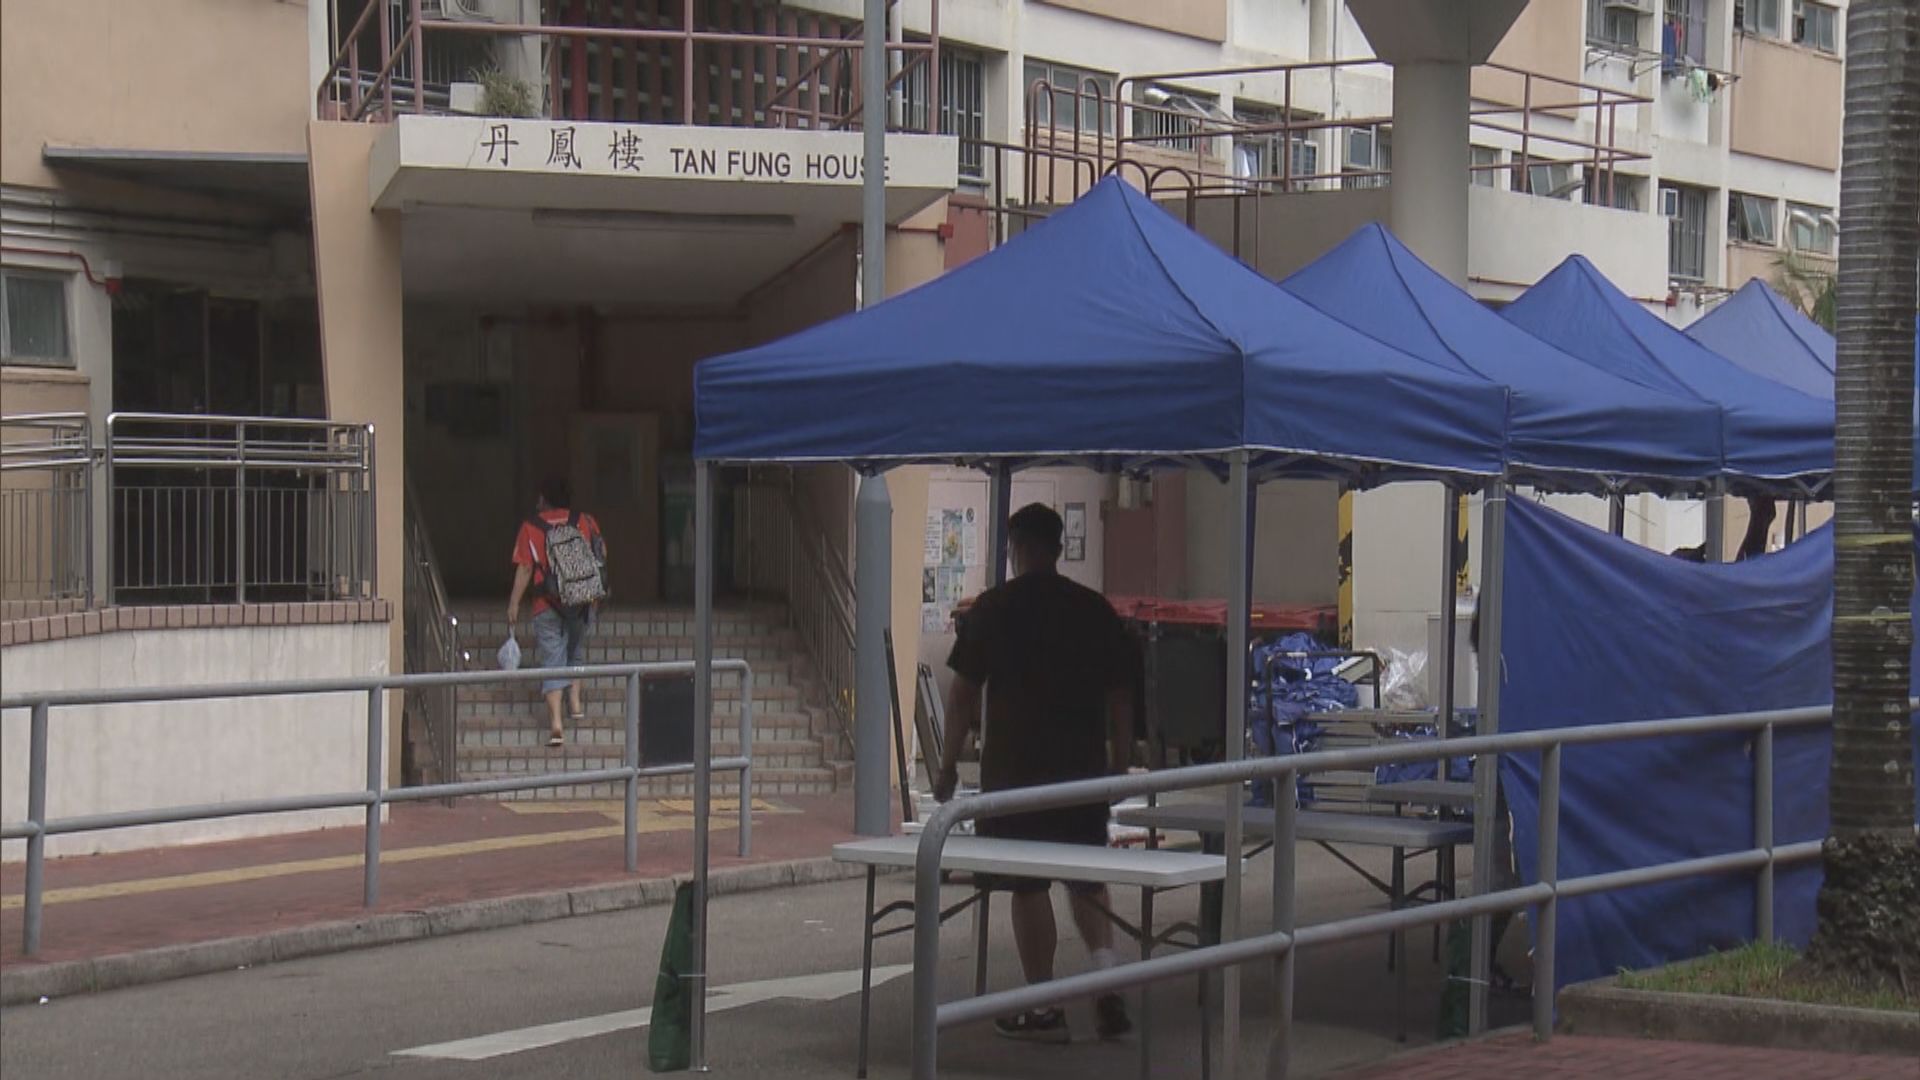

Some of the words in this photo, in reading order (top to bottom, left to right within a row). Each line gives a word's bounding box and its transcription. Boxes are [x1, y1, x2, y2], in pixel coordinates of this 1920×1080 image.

[481, 123, 645, 172] 丹鳳樓
[670, 148, 716, 175] TAN
[727, 151, 791, 178] FUNG
